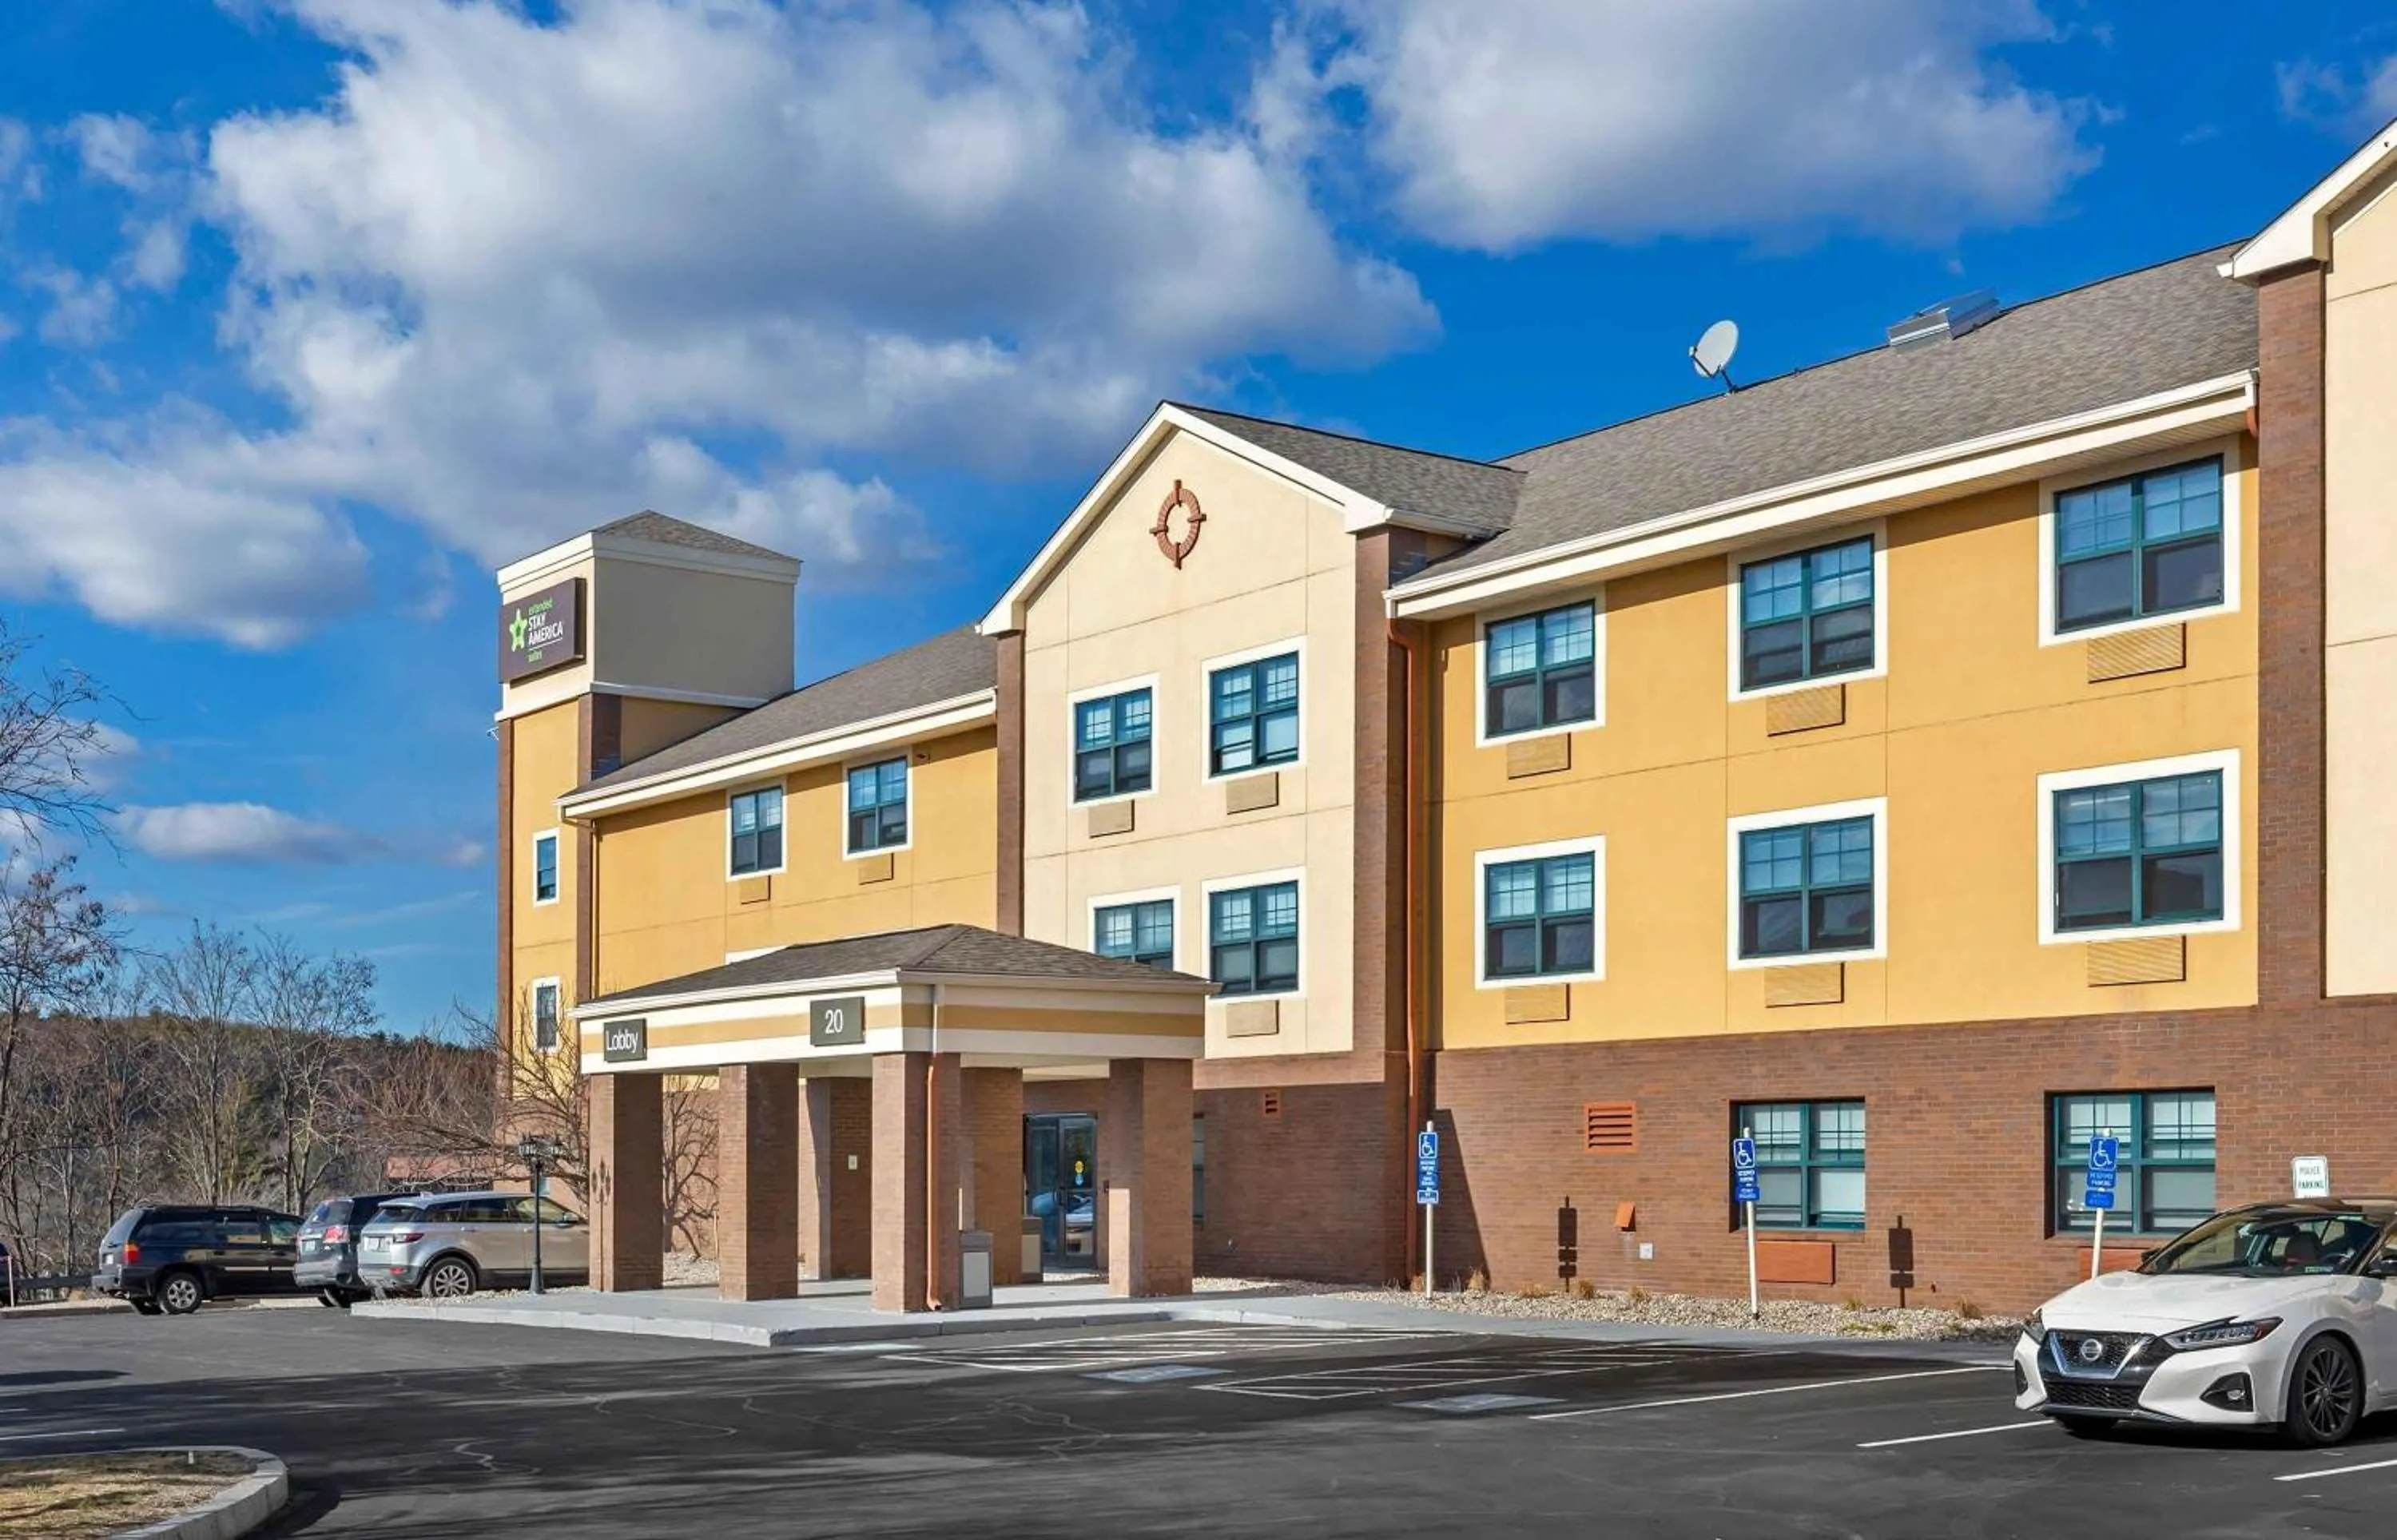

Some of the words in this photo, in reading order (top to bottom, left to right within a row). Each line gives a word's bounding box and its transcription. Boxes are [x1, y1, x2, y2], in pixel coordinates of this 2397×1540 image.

[528, 612, 547, 632] STAY
[528, 621, 563, 646] AMERICA
[825, 1009, 844, 1034] 20
[606, 1028, 638, 1054] Lobby
